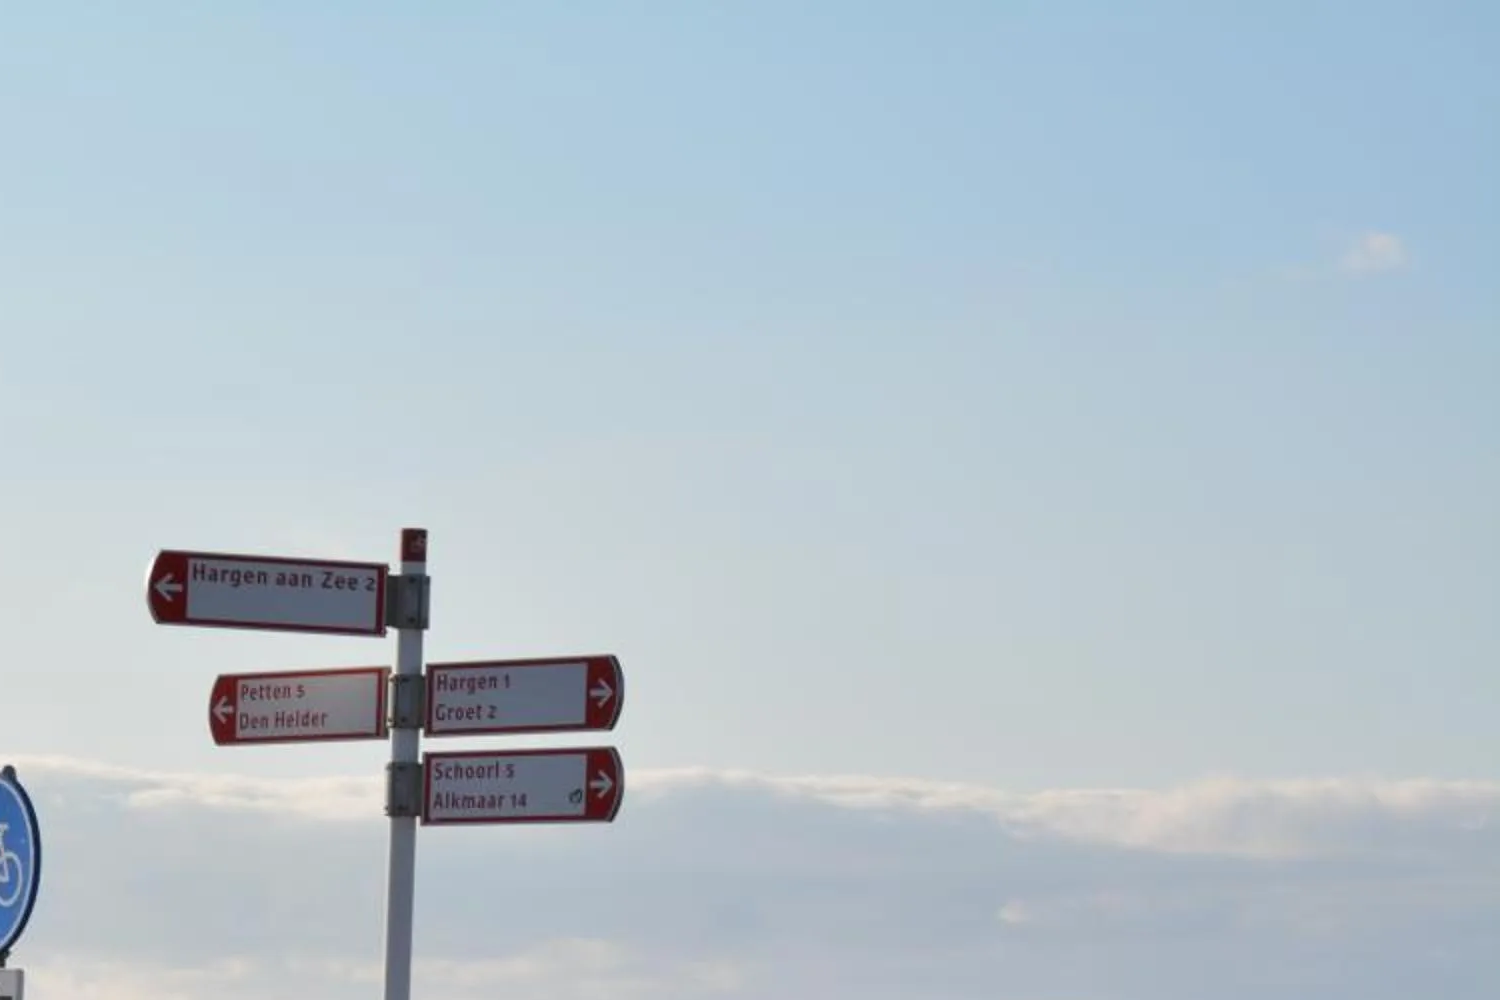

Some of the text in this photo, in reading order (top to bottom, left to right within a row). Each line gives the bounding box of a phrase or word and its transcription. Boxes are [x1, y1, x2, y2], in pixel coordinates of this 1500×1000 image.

[193, 562, 376, 592] Hargen aan Zee 2
[240, 684, 291, 701] Petten
[436, 674, 510, 695] Hargen 1
[239, 711, 328, 731] Den Helder
[435, 704, 498, 721] Groet 2
[434, 761, 499, 781] Schoorl
[433, 792, 528, 810] Alkmaar 14
